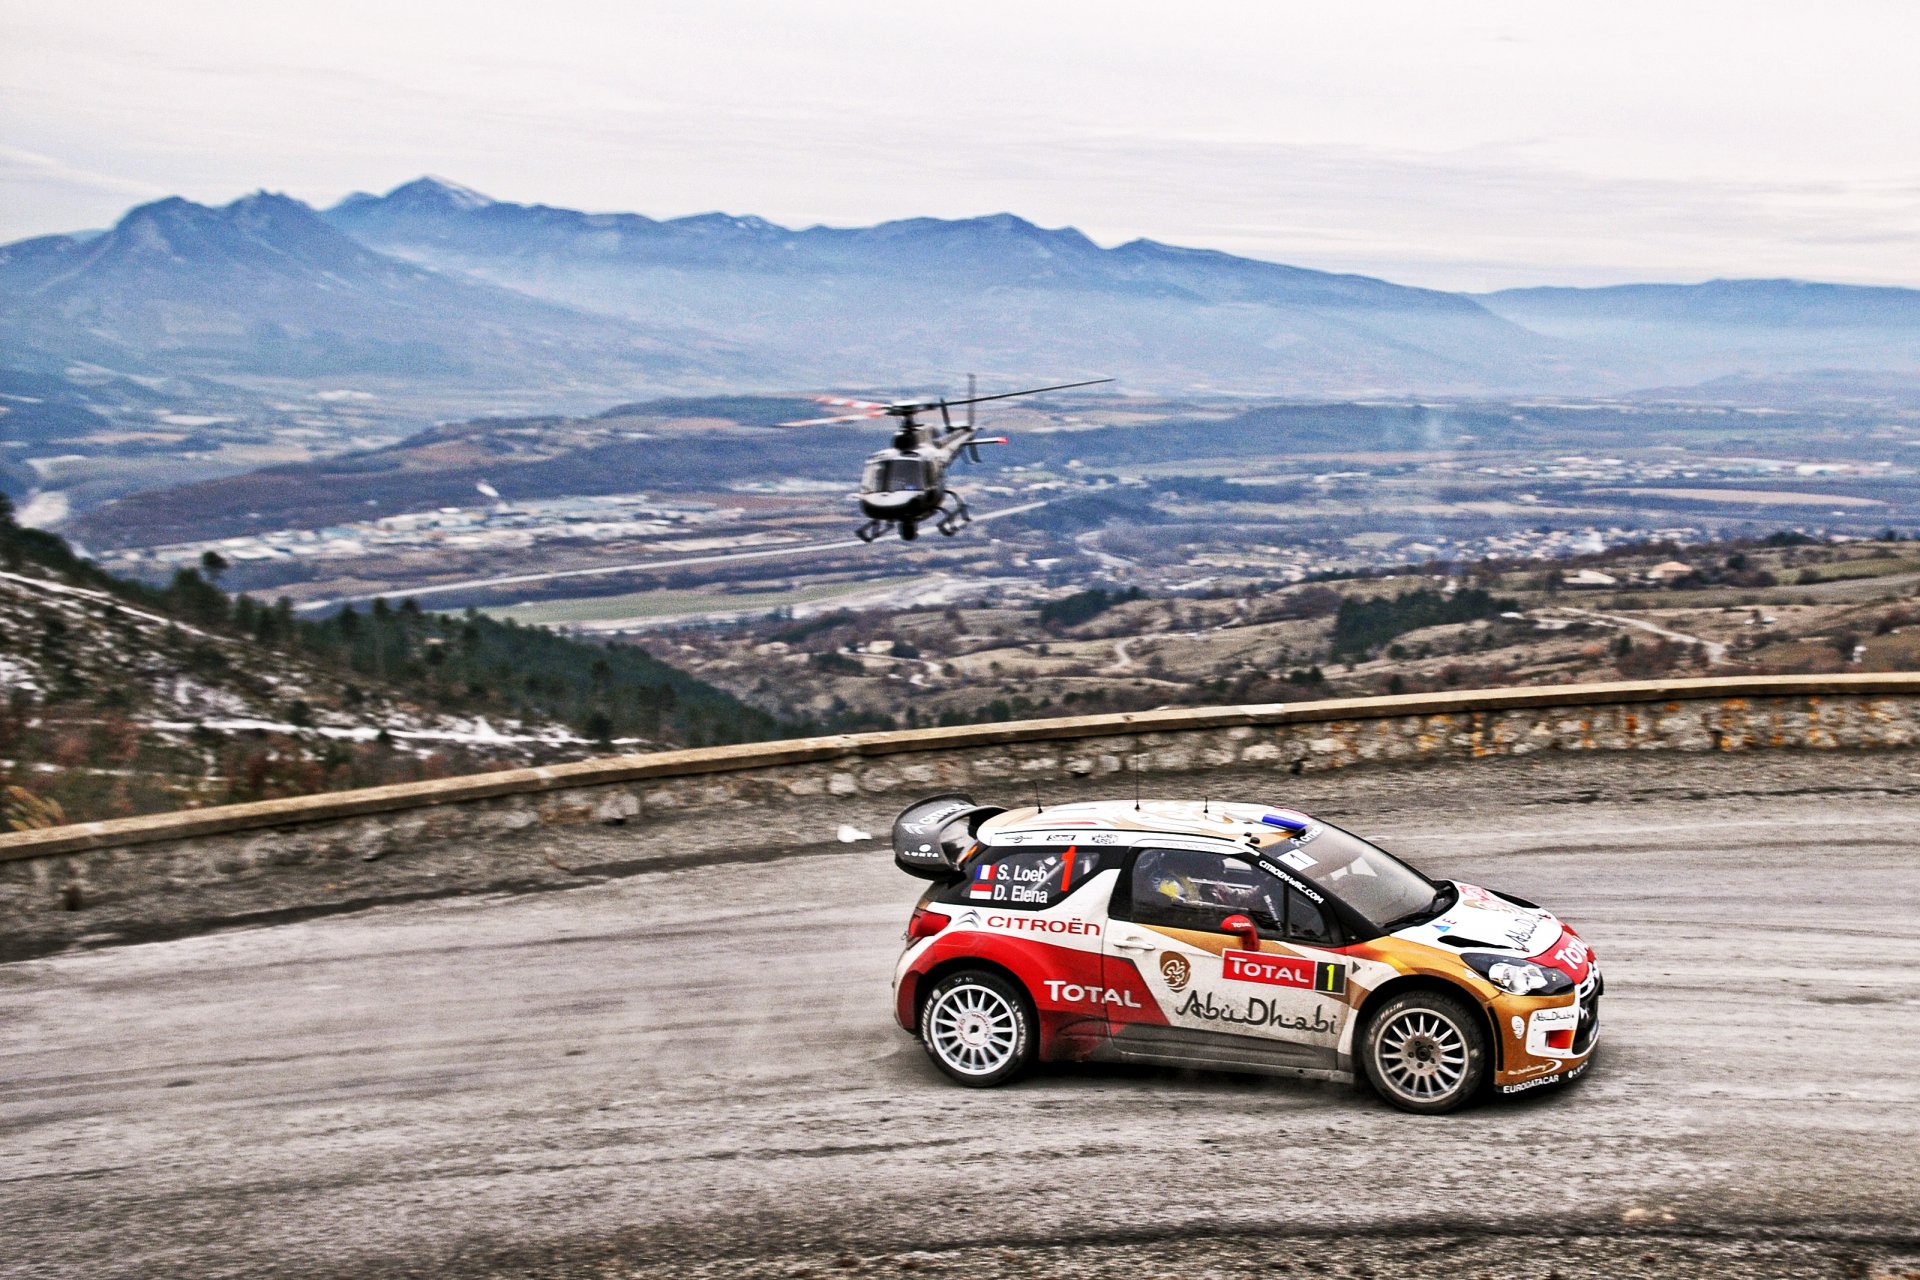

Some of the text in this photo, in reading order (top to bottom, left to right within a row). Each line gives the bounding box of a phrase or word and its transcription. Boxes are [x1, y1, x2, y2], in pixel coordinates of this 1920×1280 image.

[996, 863, 1048, 882] S. Loeb
[1061, 845, 1076, 891] 1
[993, 884, 1048, 904] D. Elena
[1228, 956, 1335, 991] TOTAL 1
[1043, 980, 1142, 1008] TOTAL
[1175, 989, 1338, 1034] Abu Dhabi
[1503, 1074, 1559, 1094] EURODATACAR
